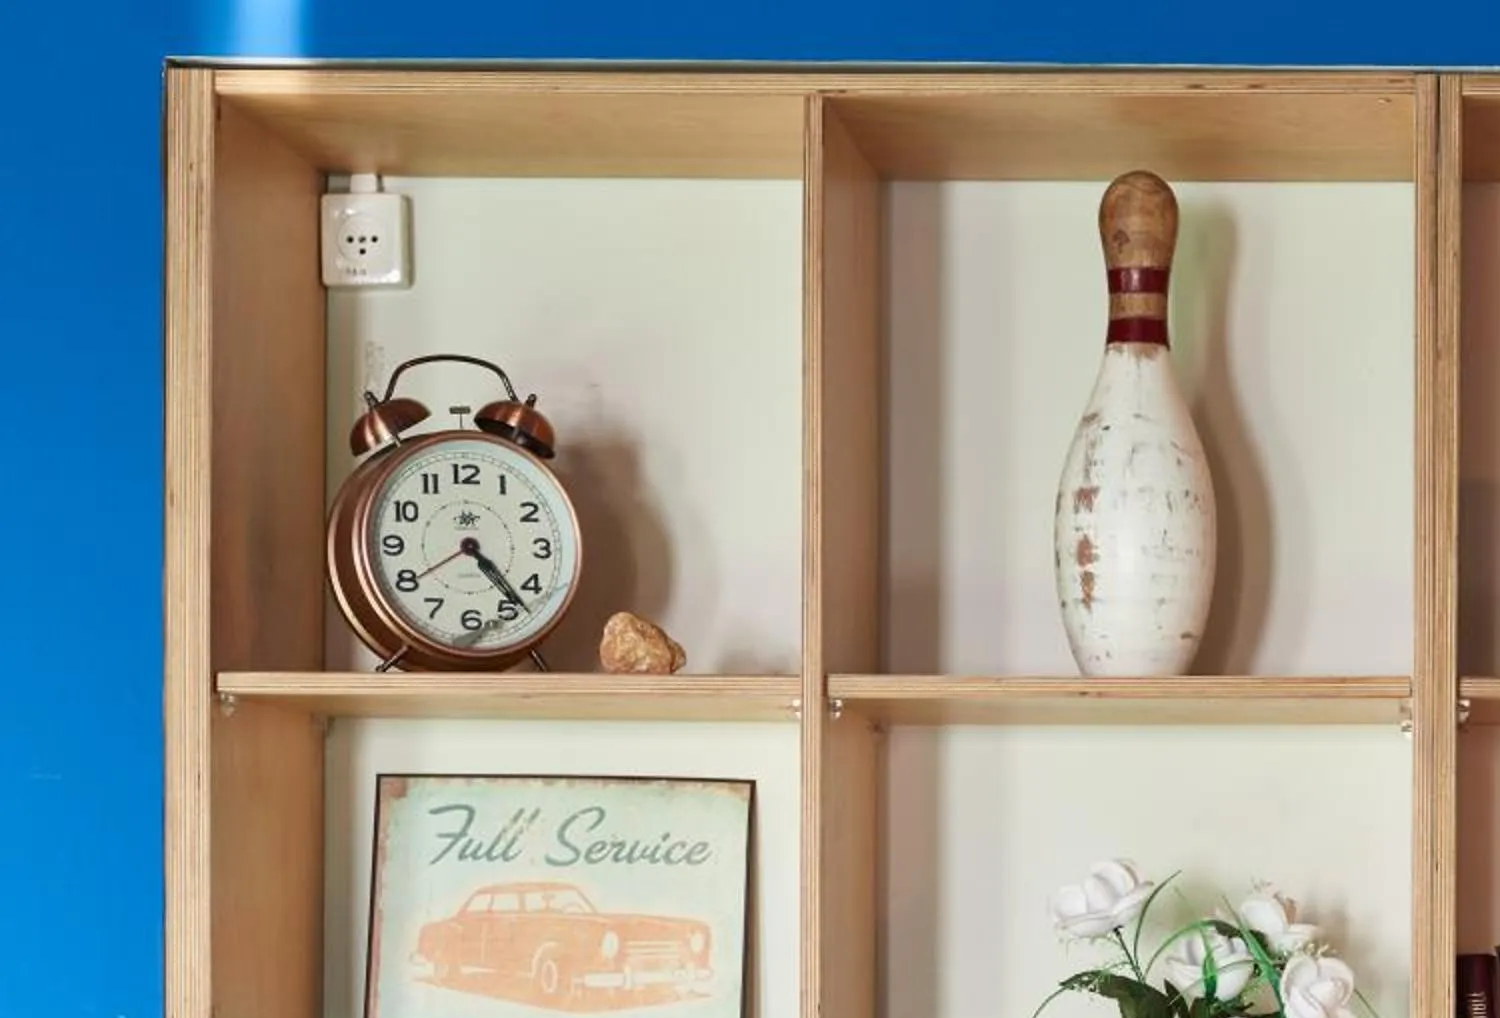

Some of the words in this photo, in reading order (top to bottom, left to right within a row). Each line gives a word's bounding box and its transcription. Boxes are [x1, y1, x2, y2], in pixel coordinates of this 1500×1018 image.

[422, 474, 440, 494] 11
[452, 465, 480, 485] 12
[498, 474, 507, 495] 1
[395, 501, 419, 522] 10
[520, 502, 539, 522] 2
[383, 536, 404, 556] 9
[533, 539, 552, 559] 3
[396, 570, 419, 592] 8
[521, 573, 542, 594] 4
[425, 598, 444, 618] 7
[498, 600, 518, 620] 5
[462, 611, 482, 630] 6
[428, 804, 539, 866] Full
[546, 806, 713, 867] Service
